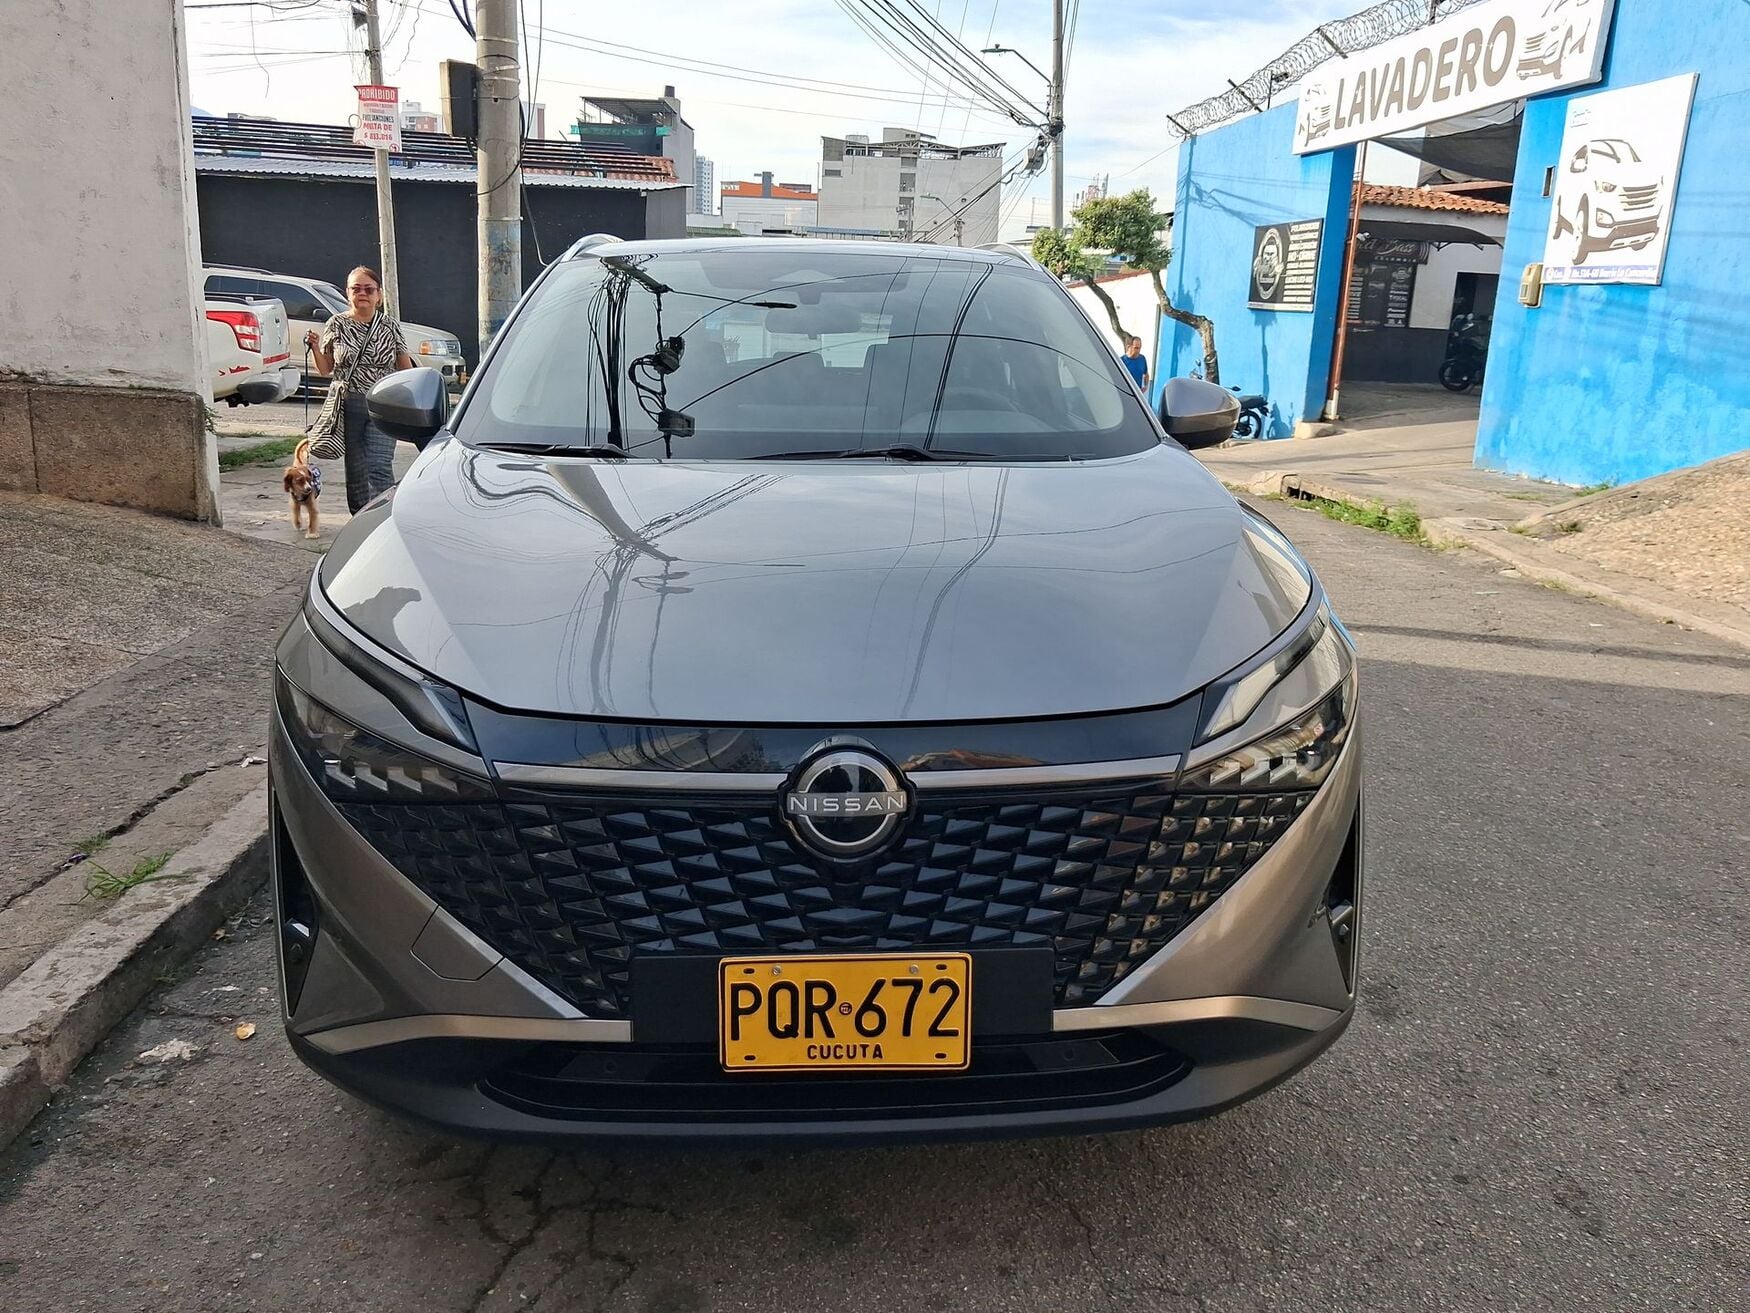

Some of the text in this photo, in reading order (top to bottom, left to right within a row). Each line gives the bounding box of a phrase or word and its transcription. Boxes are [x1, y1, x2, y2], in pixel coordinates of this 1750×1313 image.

[1334, 15, 1516, 130] LAVADERO
[790, 795, 904, 811] NISSAN
[731, 978, 960, 1040] PQR 672
[807, 1043, 883, 1060] CUCUTA
